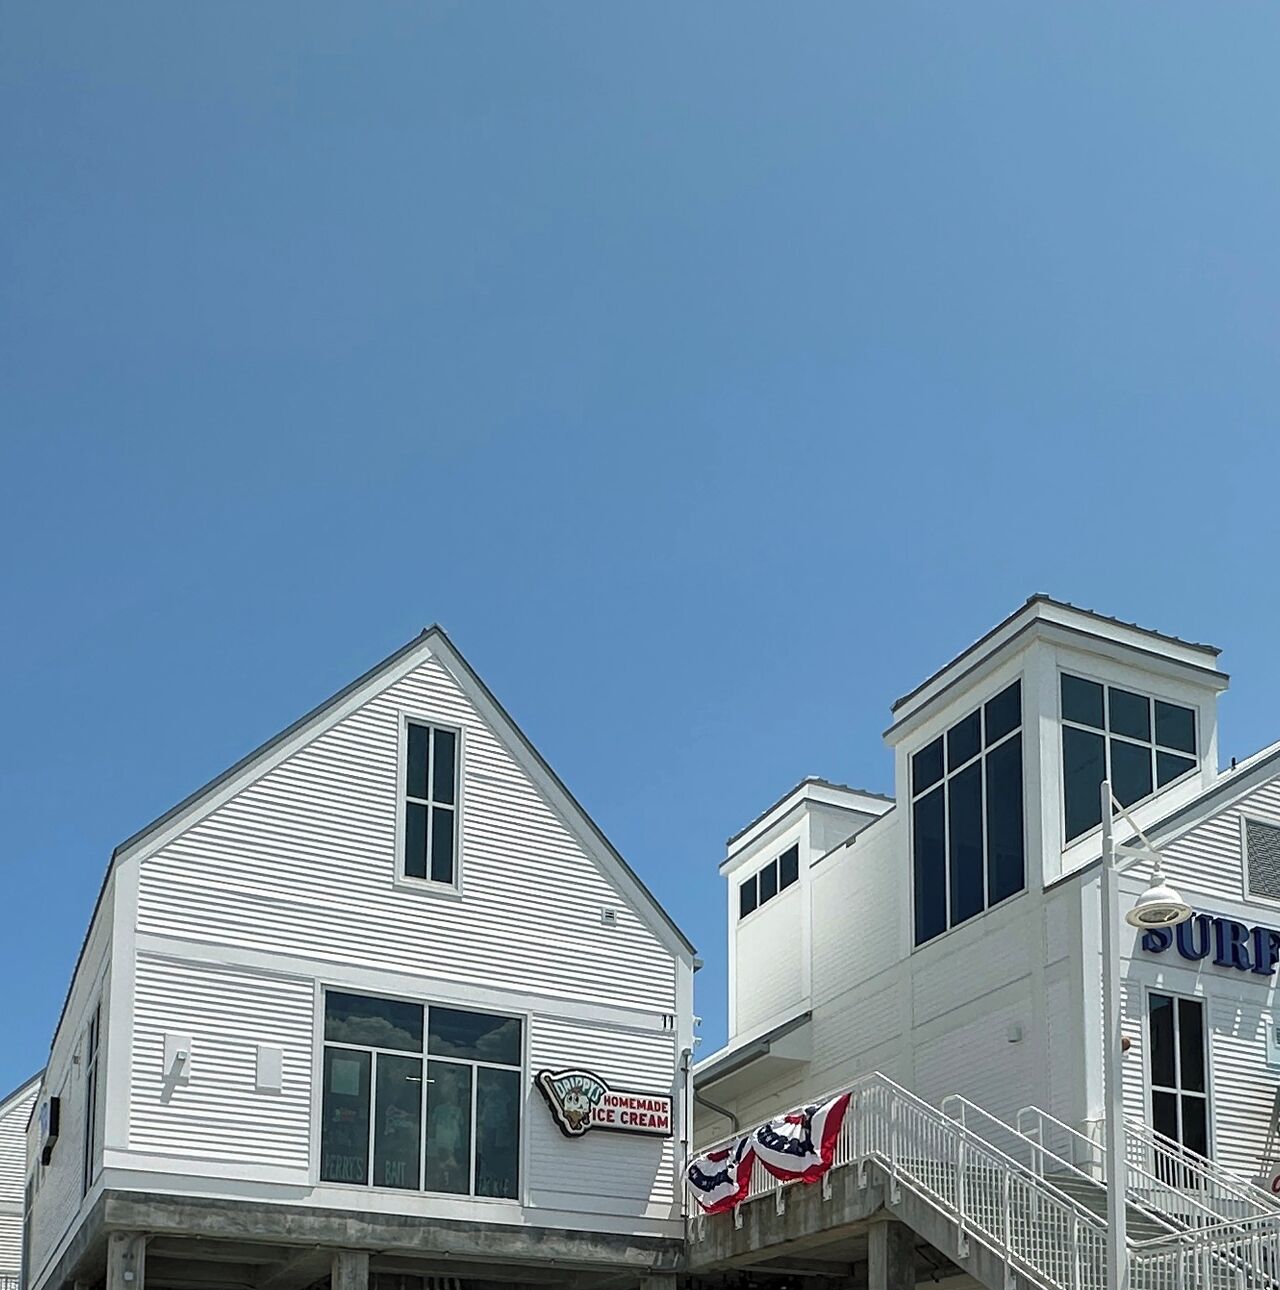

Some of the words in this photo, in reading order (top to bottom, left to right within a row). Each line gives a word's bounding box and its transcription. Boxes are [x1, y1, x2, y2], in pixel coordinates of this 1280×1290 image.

[604, 1095, 668, 1113] HOMEMADE
[593, 1109, 615, 1123] ICE
[620, 1112, 668, 1128] CREAM
[384, 1160, 407, 1186] BAIT
